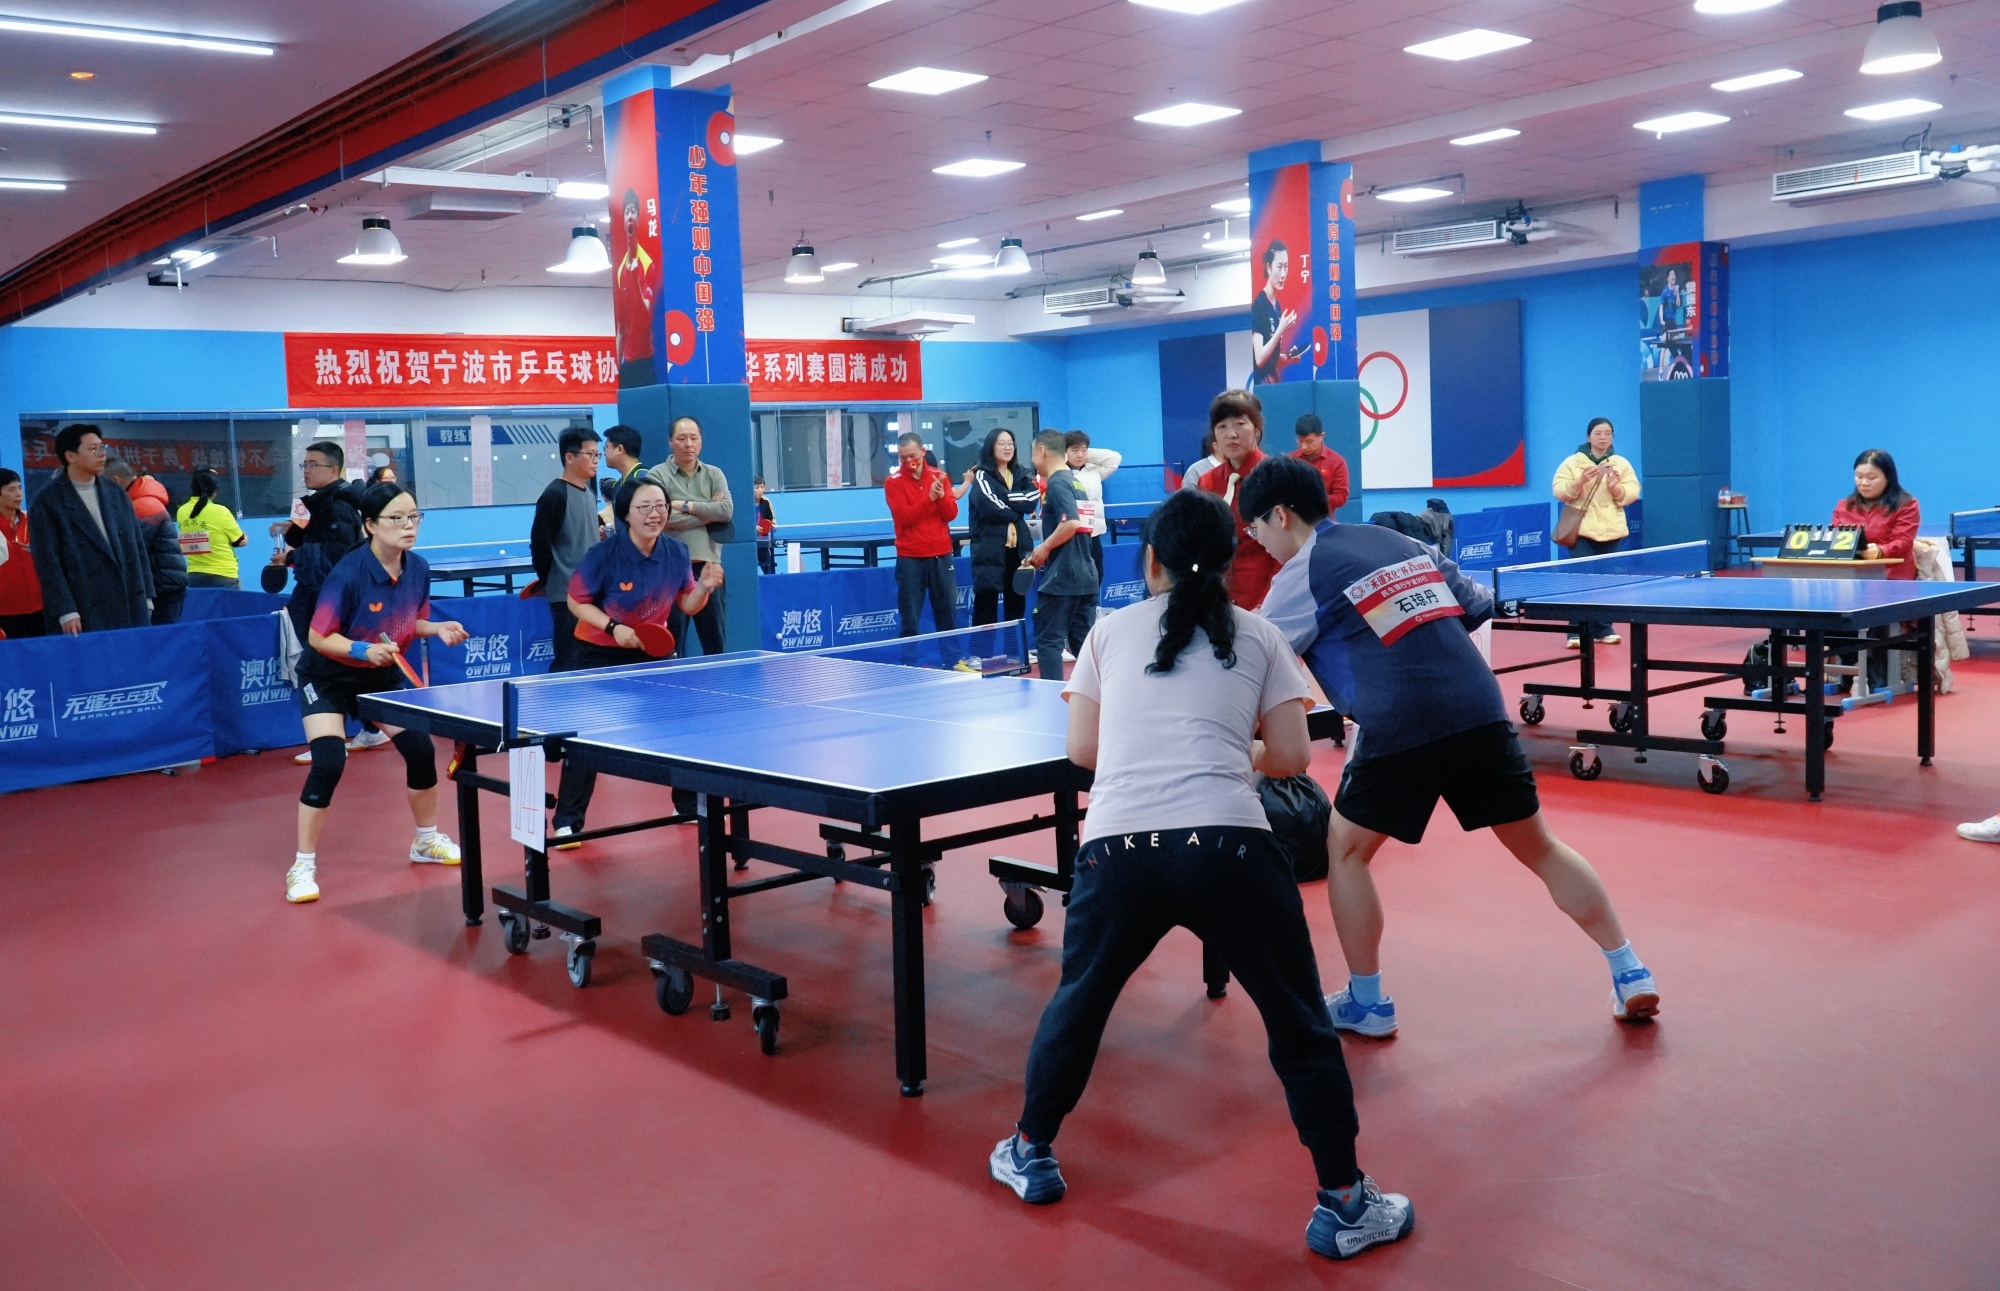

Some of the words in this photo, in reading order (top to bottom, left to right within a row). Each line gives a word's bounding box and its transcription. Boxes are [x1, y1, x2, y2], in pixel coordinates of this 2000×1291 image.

[646, 198, 658, 237] 马龙
[688, 145, 715, 331] 少年强则中国强
[1300, 254, 1309, 283] 丁宁
[315, 349, 619, 385] 热烈祝贺宁波市乒乓球协
[746, 352, 908, 384] 华系列赛圆满成功
[1790, 531, 1809, 549] 0
[1814, 531, 1821, 541] 1
[1825, 531, 1832, 541] 1
[1833, 532, 1853, 549] 2
[1395, 589, 1439, 613] 石琼丹
[782, 609, 822, 635] 澳悠
[837, 612, 897, 632] 无缝乒乓球
[465, 633, 509, 663] 澳悠
[782, 634, 823, 648] OWNWIN
[466, 662, 511, 678] OWNWIN
[0, 688, 35, 722] 悠
[61, 685, 163, 719] 无缝乒乓球
[242, 688, 292, 704] OWNWIN
[72, 709, 133, 721] SEAMLESS
[136, 705, 163, 715] BALL
[1088, 832, 1159, 869] NIKE
[1187, 831, 1247, 859] AIR
